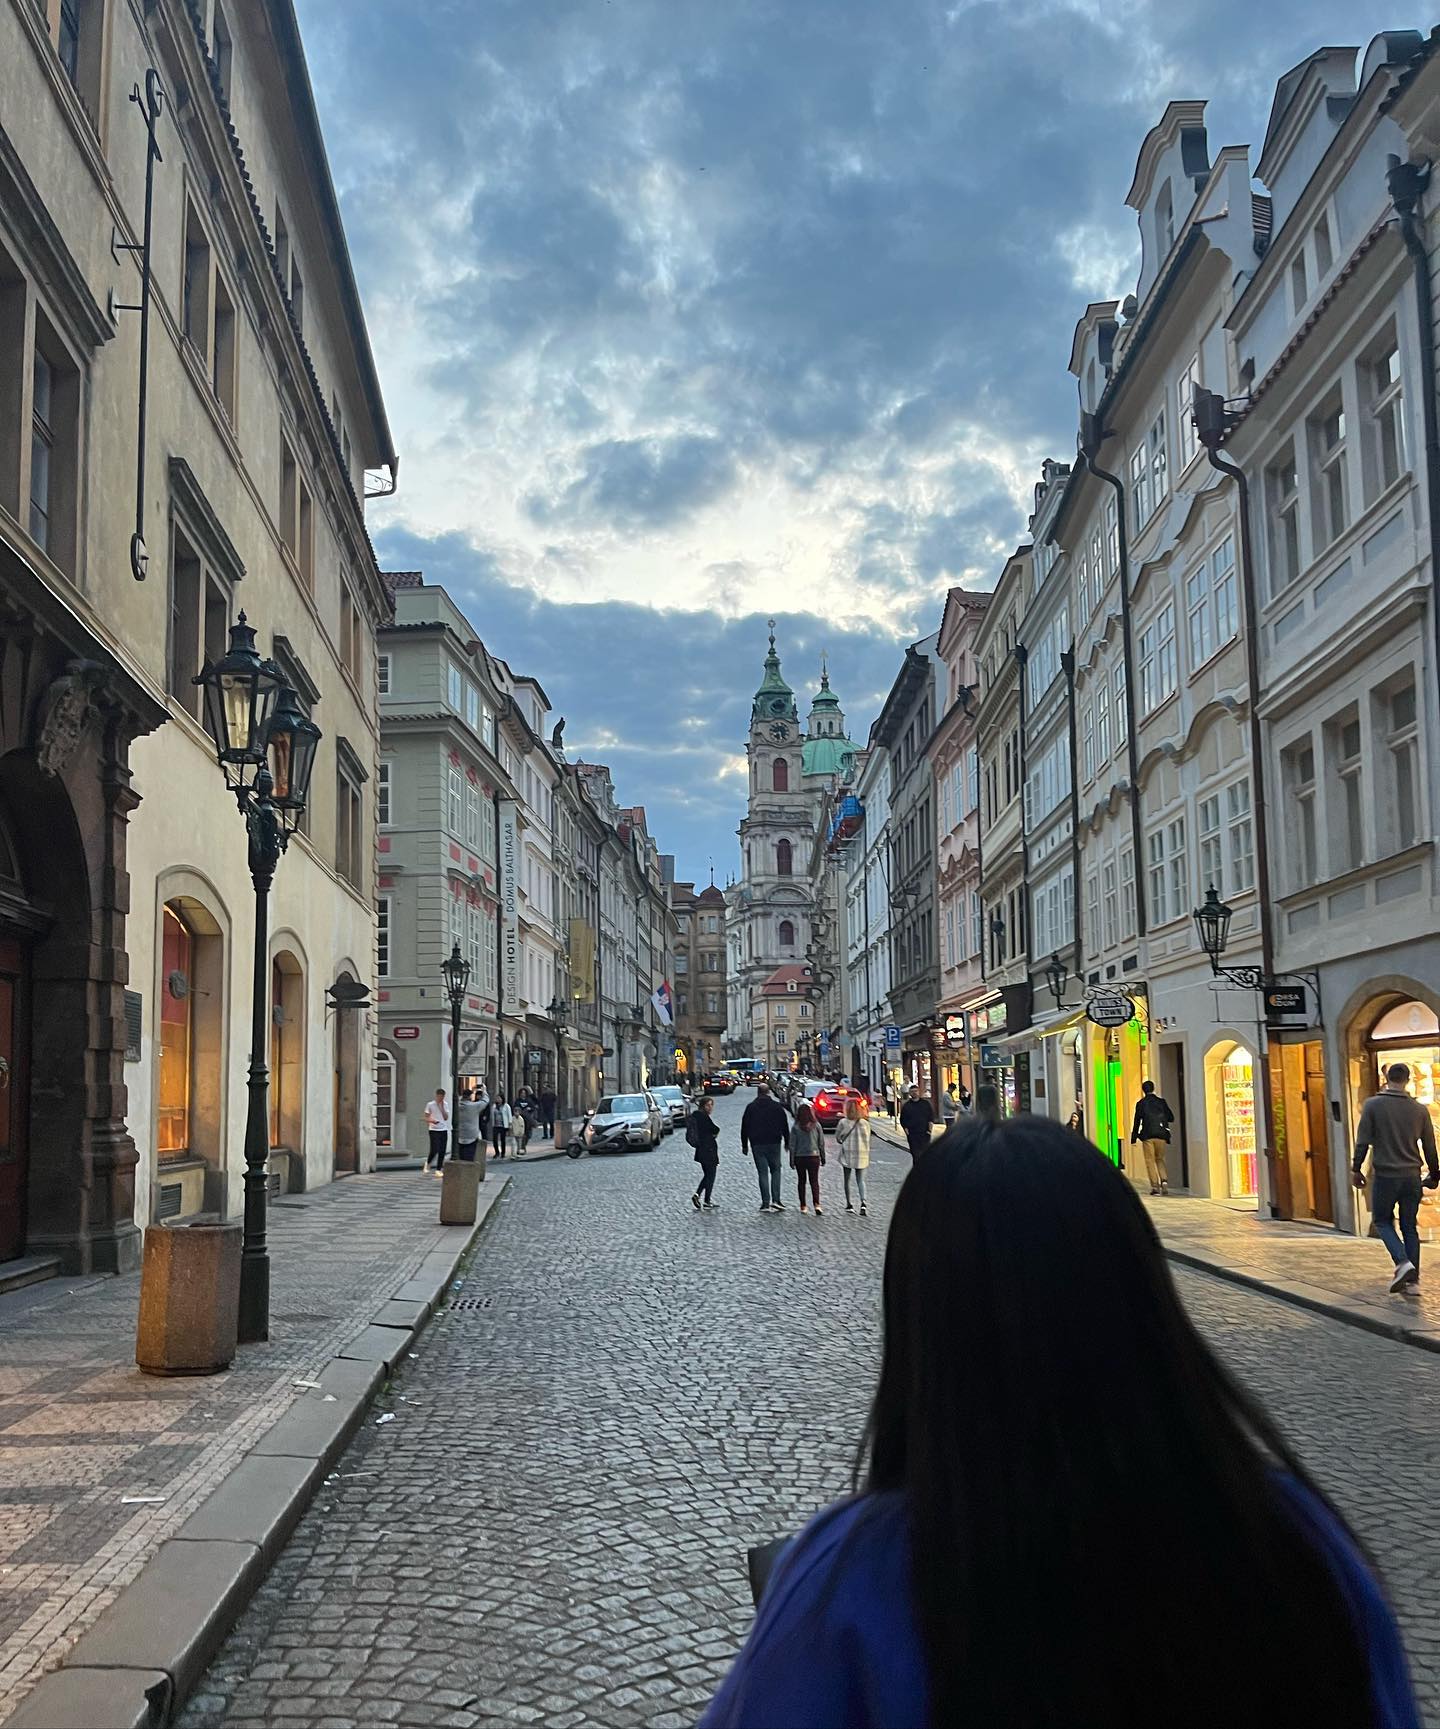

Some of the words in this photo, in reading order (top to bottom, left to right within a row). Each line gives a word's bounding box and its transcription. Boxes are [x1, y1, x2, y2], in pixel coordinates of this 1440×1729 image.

[504, 823, 514, 874] BALTHASAR
[505, 876, 514, 913] DOMUS
[506, 927, 515, 964] HOTEL
[507, 967, 516, 1005] DESIGN
[1099, 1008, 1122, 1016] TOWN
[888, 1029, 898, 1041] P
